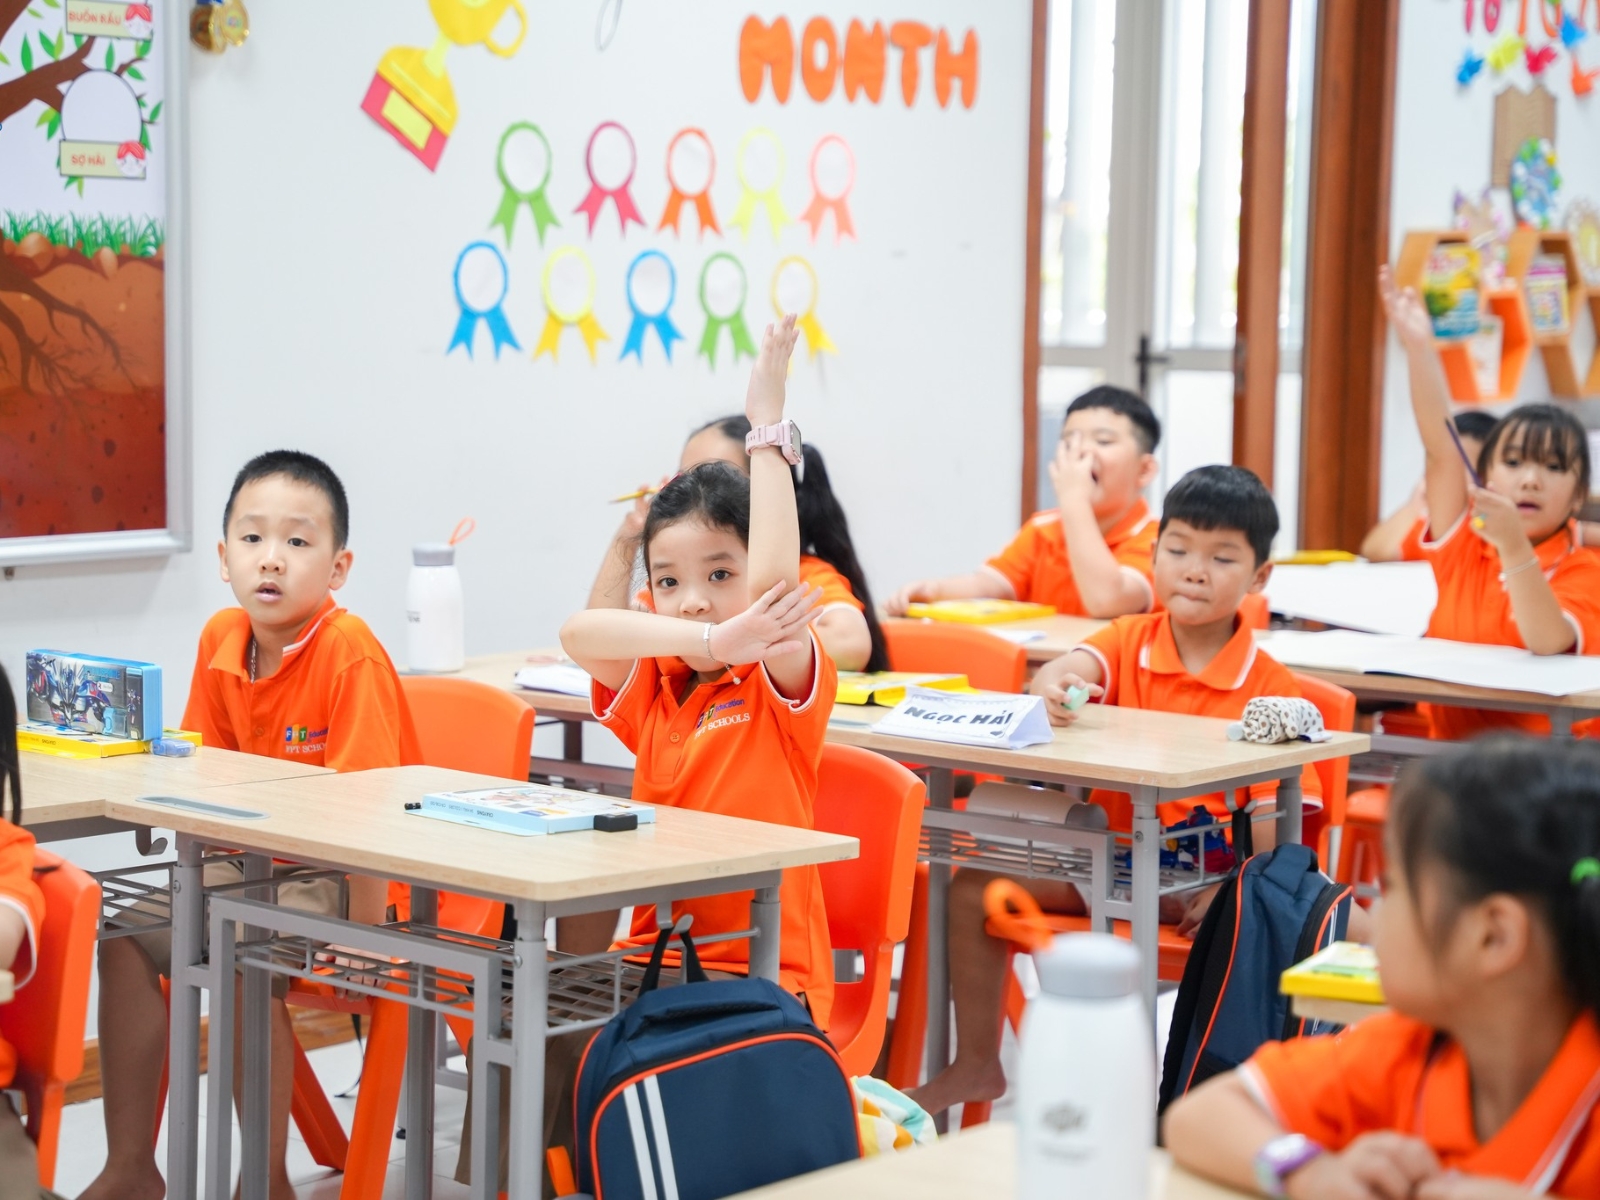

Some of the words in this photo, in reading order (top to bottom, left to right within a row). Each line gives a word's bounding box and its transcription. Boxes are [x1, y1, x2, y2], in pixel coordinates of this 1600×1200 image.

[738, 14, 979, 110] MONTH
[708, 712, 751, 730] SCHOOLS
[903, 706, 966, 725] NGỌC
[302, 742, 326, 753] SCHO
